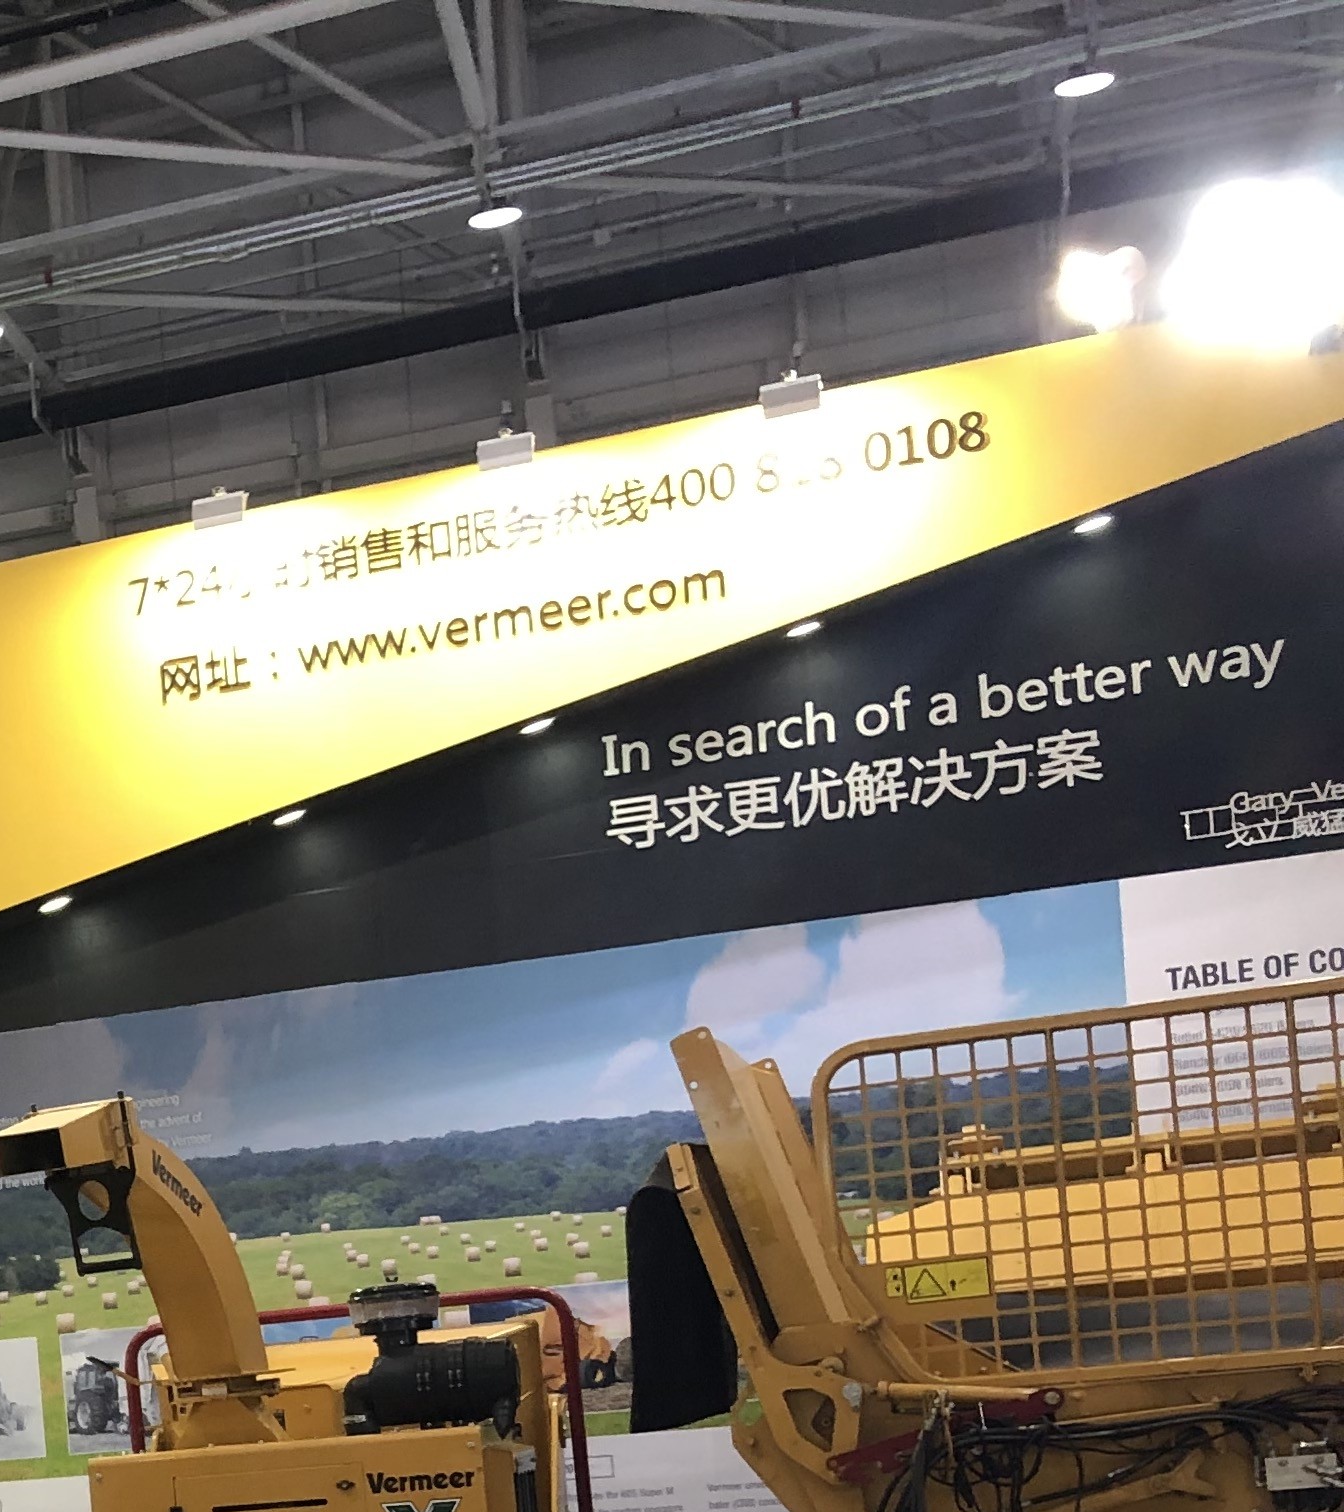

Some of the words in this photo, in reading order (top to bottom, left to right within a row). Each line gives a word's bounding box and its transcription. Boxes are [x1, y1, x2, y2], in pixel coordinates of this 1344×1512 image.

[864, 411, 991, 472] 0108
[298, 568, 727, 674] www.vermeer.com
[601, 734, 651, 777] In
[668, 700, 837, 767] search
[855, 684, 912, 738] of
[928, 691, 958, 727] a
[977, 660, 1132, 720] better
[1167, 638, 1286, 690] way
[606, 728, 1105, 850] 寻求更优解决方案
[1164, 957, 1256, 991] TABLE
[1263, 952, 1300, 980] OF
[152, 1149, 203, 1217] Vermeer
[366, 1471, 475, 1495] Vermeer
